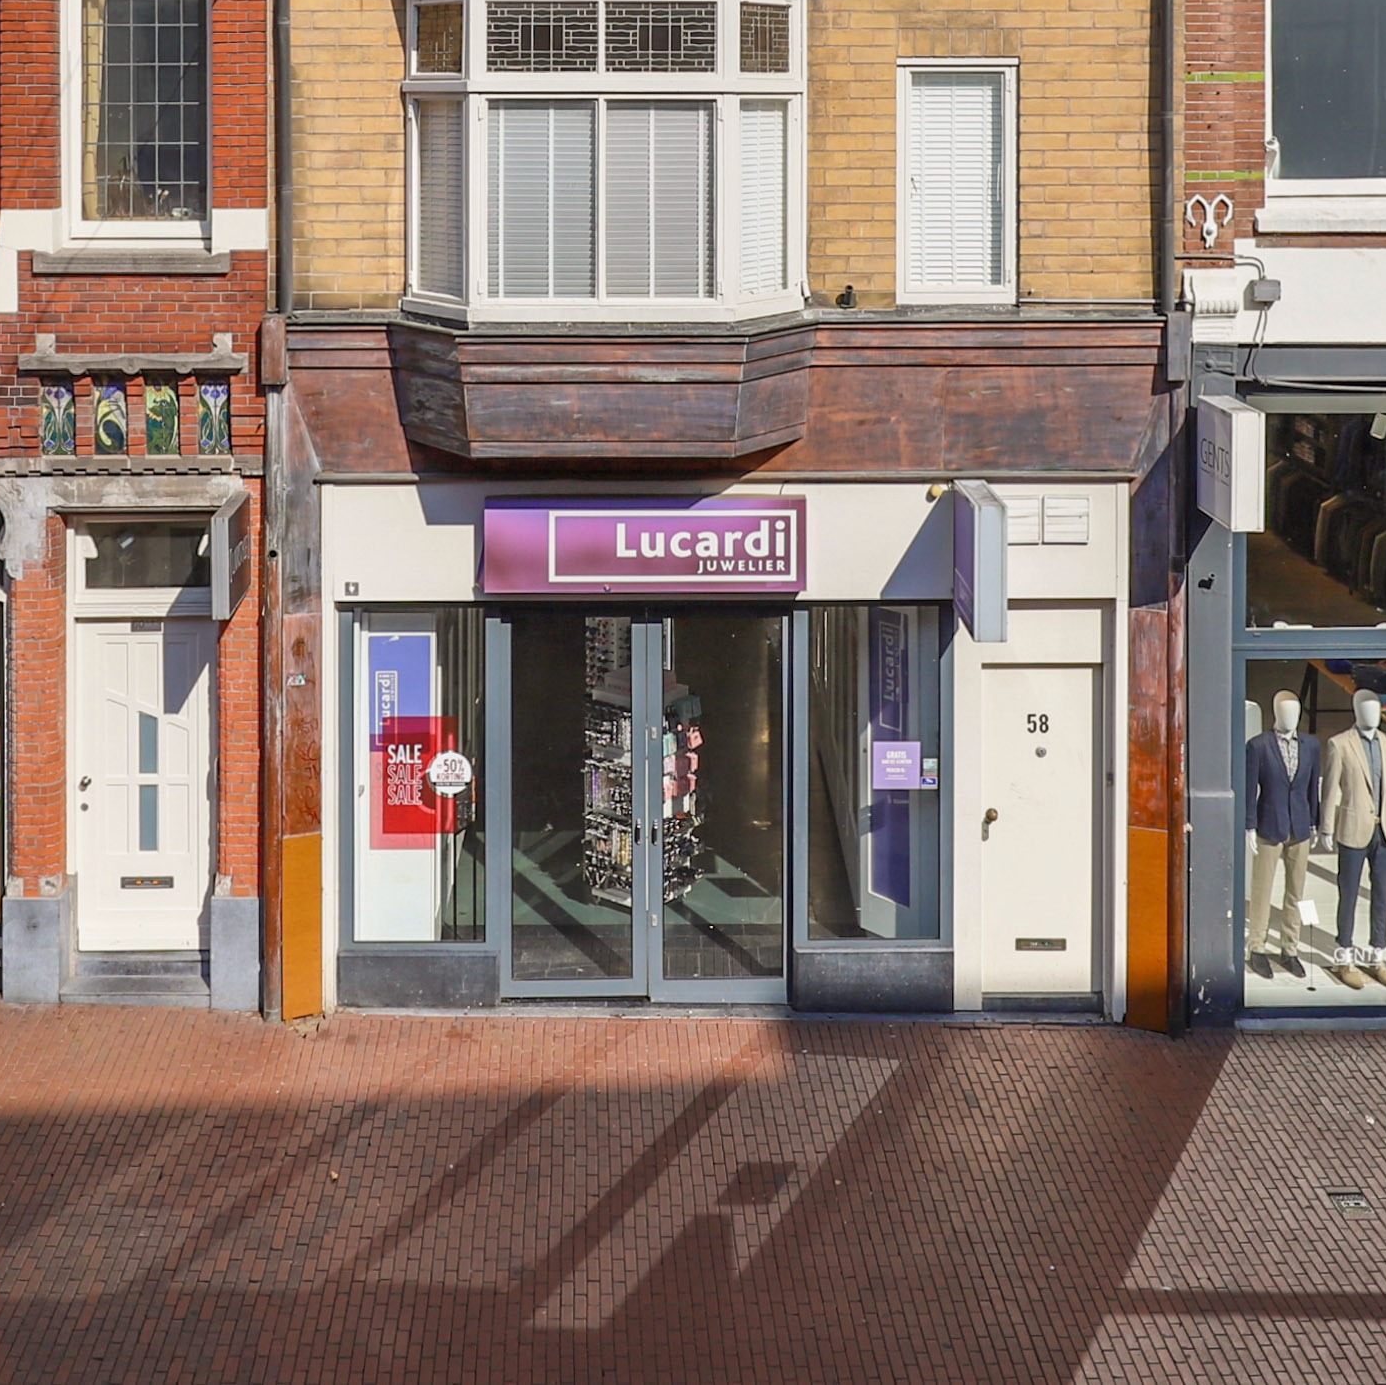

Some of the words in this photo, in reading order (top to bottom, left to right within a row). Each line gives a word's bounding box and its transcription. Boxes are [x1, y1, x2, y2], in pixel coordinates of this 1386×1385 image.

[1200, 438, 1230, 478] GENTS
[616, 519, 786, 558] Lucardi
[697, 560, 786, 574] JUWELIER
[882, 622, 895, 702] Lucardi
[378, 674, 391, 726] Lucardi
[1027, 713, 1049, 734] 58
[387, 744, 423, 764] SALE
[387, 764, 423, 785] SALE
[387, 784, 423, 805] SALE
[1333, 947, 1383, 962] GENTS
